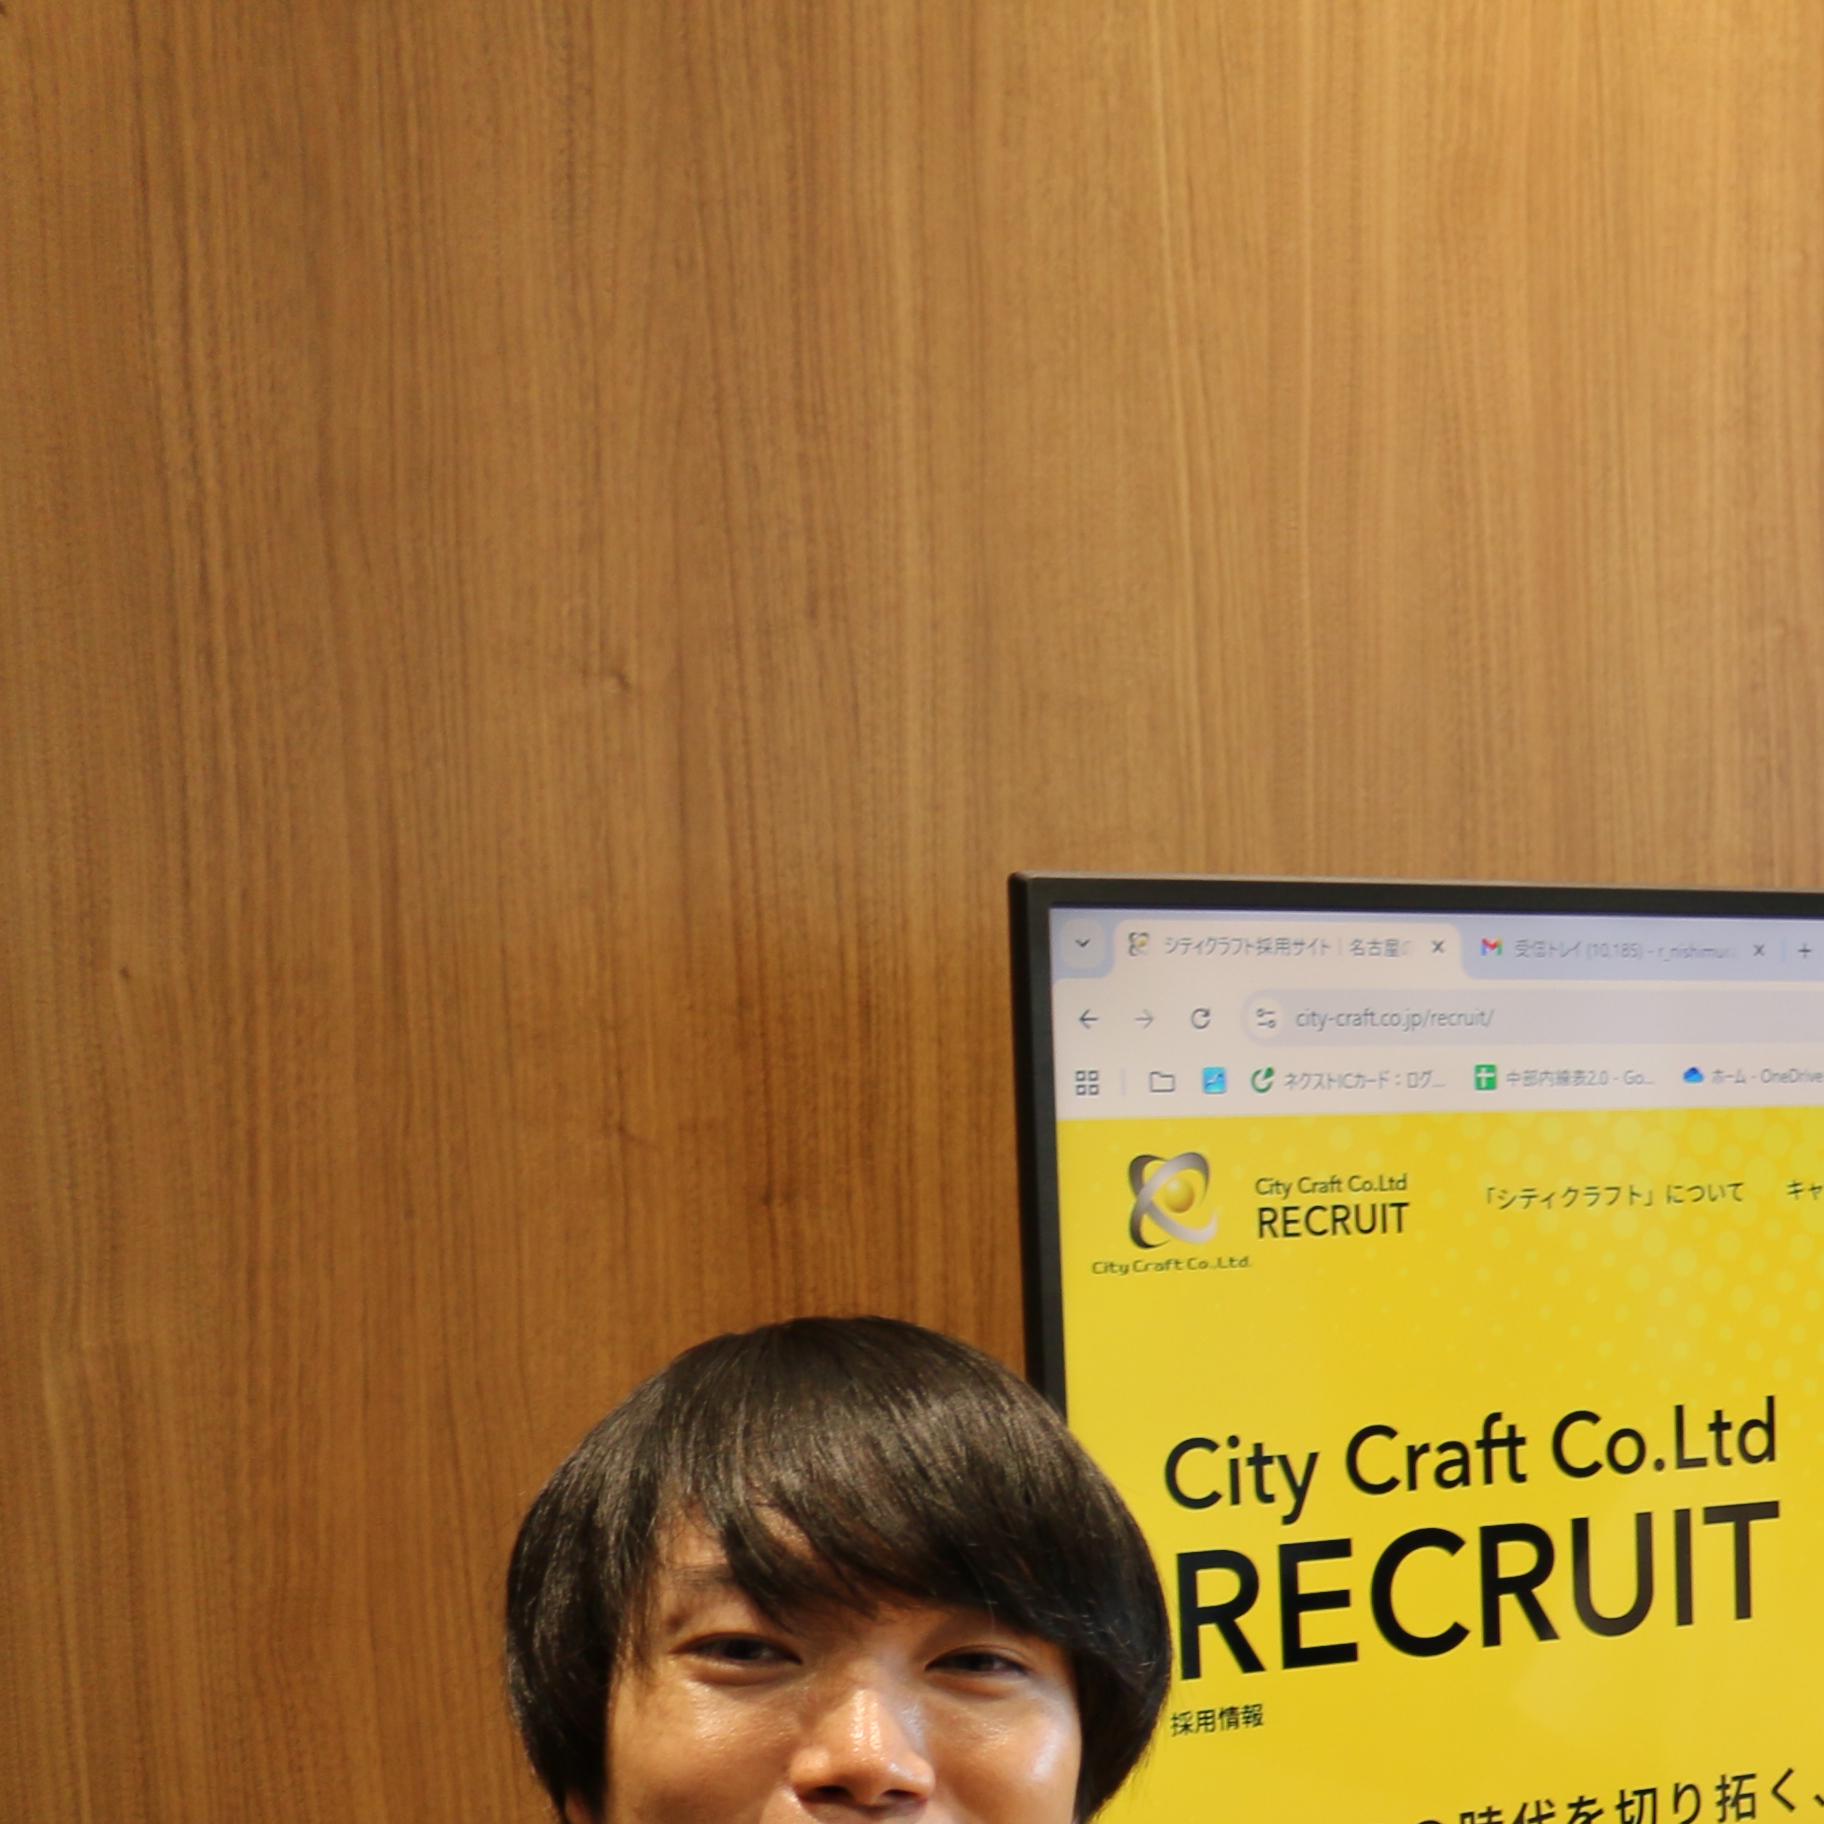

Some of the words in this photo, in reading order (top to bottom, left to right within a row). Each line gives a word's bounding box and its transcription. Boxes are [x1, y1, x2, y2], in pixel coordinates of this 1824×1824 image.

[1295, 1008, 1495, 1032] city-craft.co.jp/recruit/
[1760, 1067, 1824, 1085] OneDrive
[1255, 1177, 1293, 1201] City
[1297, 1175, 1343, 1194] Craft
[1347, 1173, 1409, 1193] Co.Ltd
[1257, 1202, 1411, 1239] RECRUIT
[1091, 1260, 1129, 1277] City
[1132, 1258, 1184, 1274] Craft
[1164, 1434, 1320, 1526] City
[1344, 1410, 1527, 1496] Craft
[1551, 1394, 1778, 1479] Co.Ltd
[1175, 1500, 1781, 1681] RECRUIT
[1169, 1704, 1264, 1737] 採用情報
